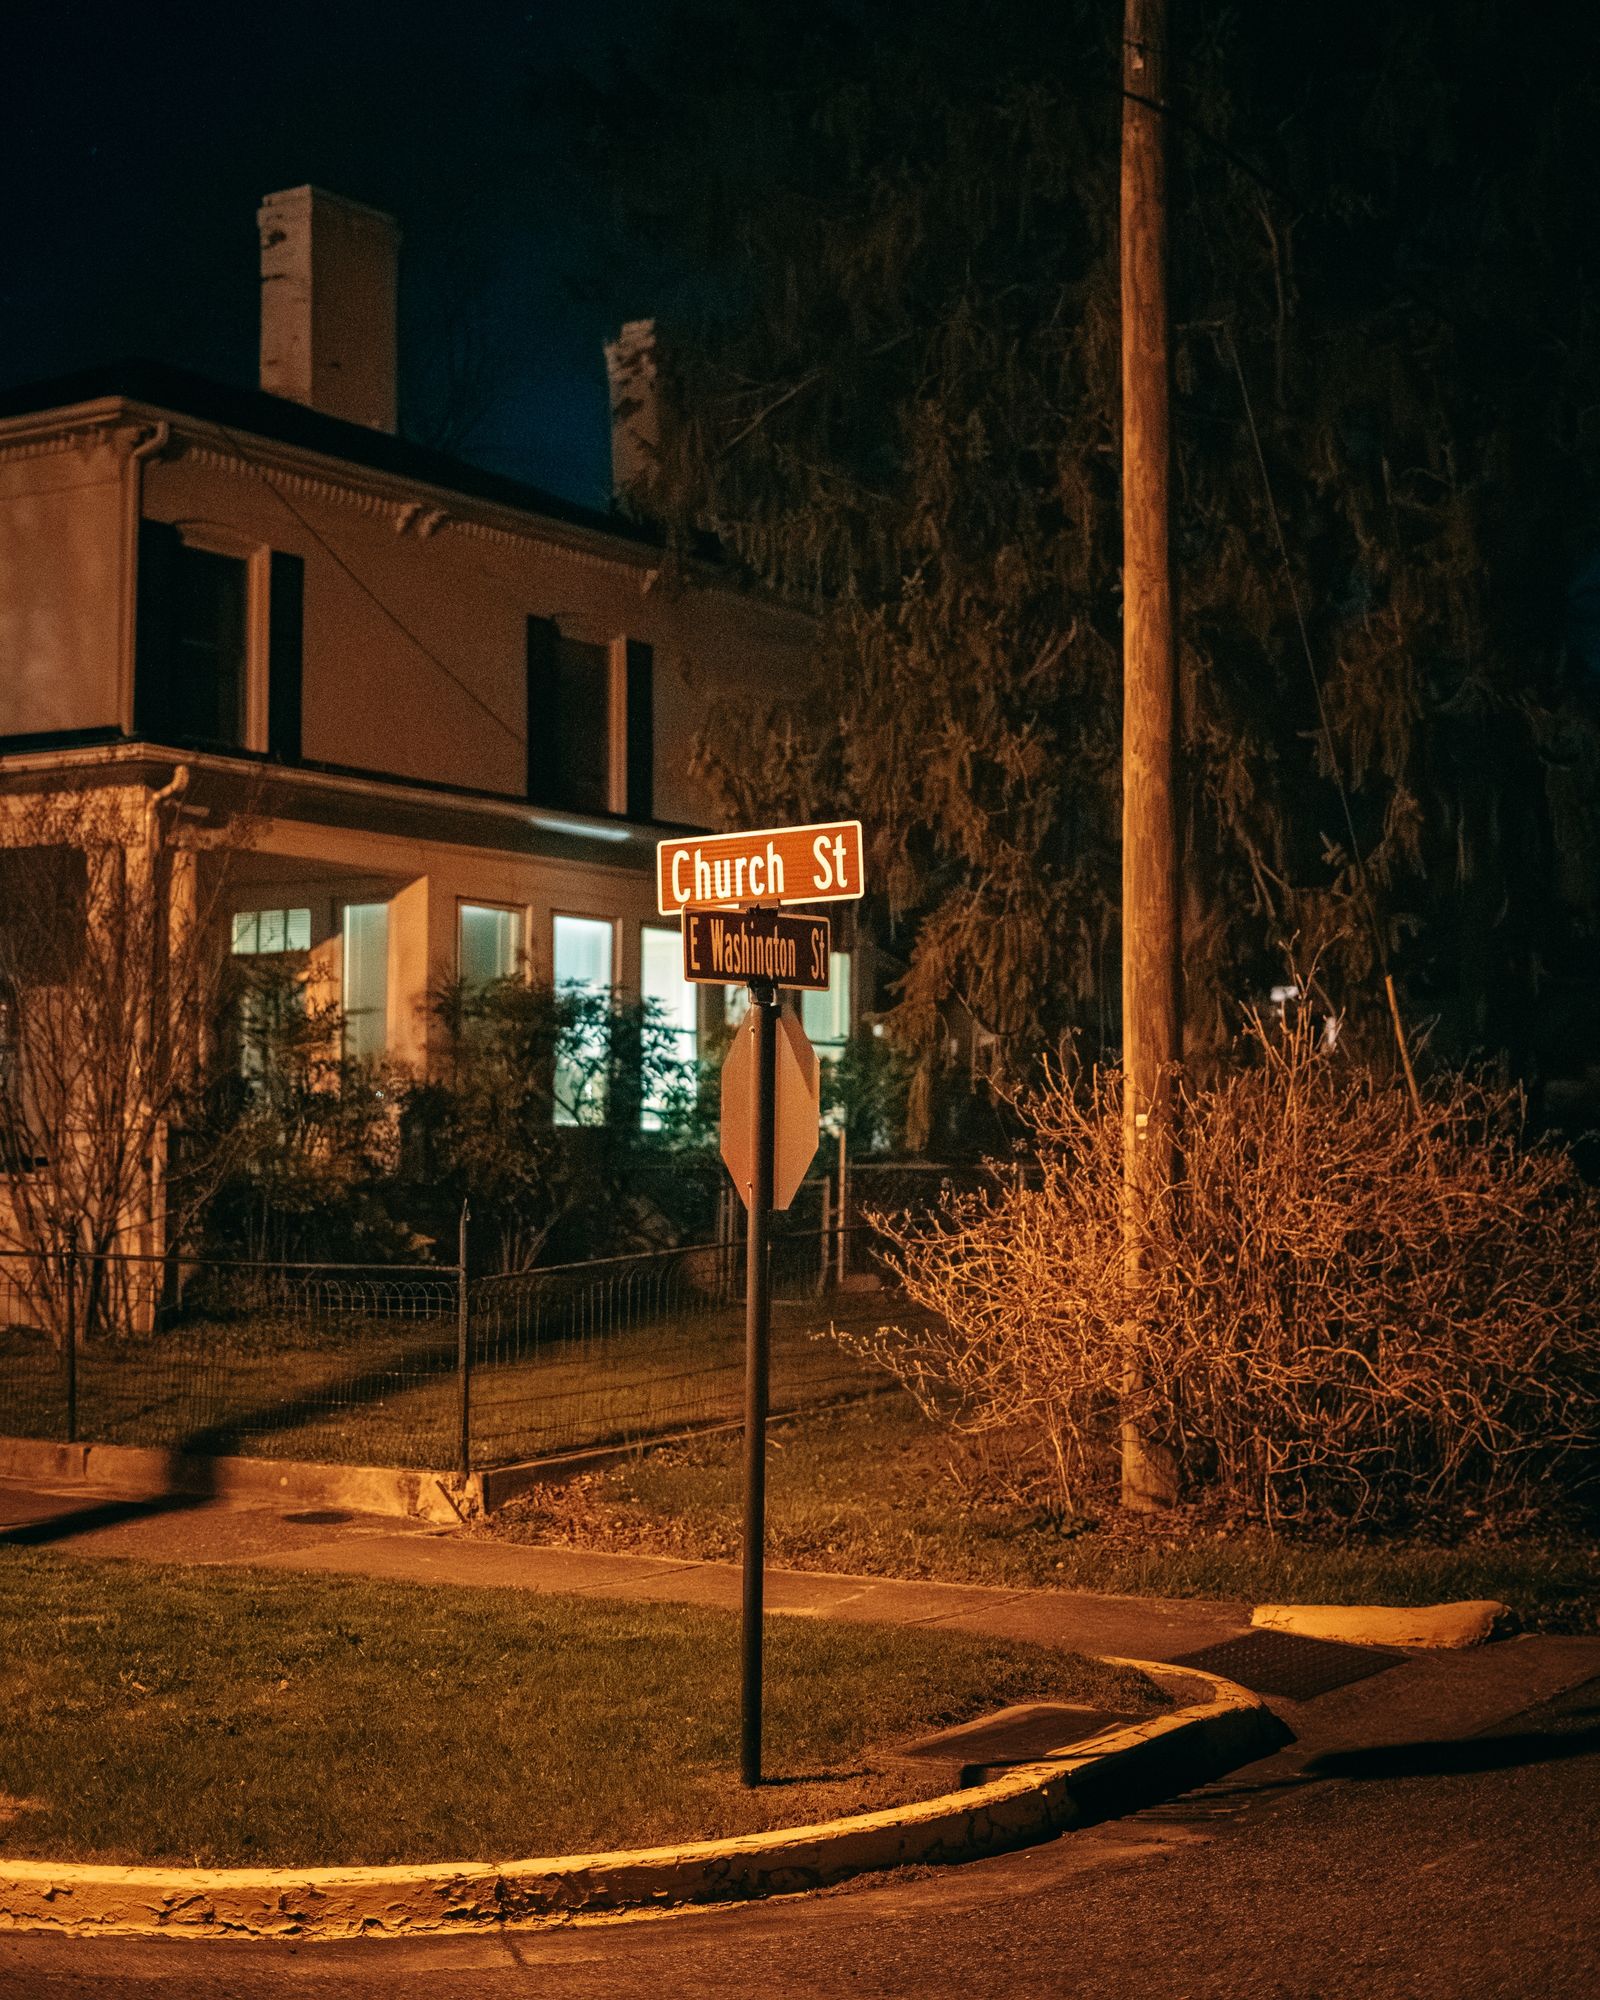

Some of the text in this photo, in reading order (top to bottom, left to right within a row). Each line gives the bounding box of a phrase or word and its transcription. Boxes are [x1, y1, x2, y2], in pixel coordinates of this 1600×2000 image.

[672, 834, 848, 903] Church St
[690, 916, 826, 980] E Washington St
